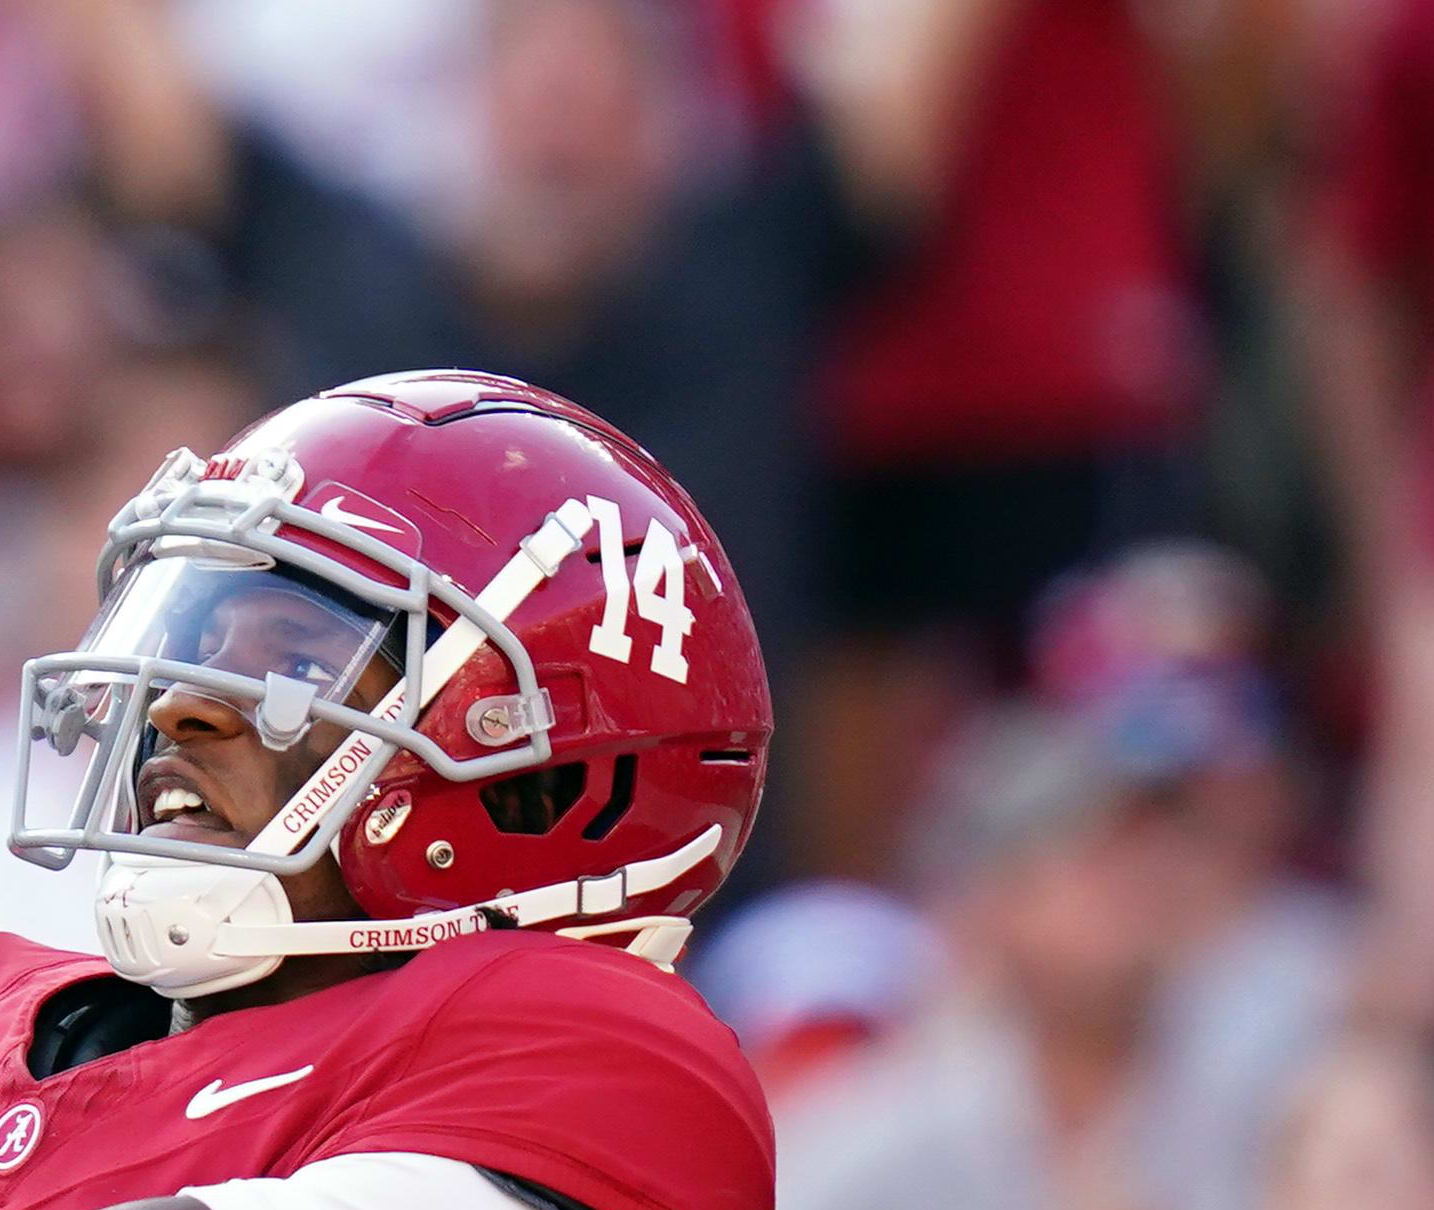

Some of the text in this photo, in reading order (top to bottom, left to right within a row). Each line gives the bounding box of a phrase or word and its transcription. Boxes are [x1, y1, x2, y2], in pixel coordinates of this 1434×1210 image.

[586, 493, 697, 685] 14
[282, 738, 373, 834] CRIMSON
[349, 917, 463, 948] CRIMSON
